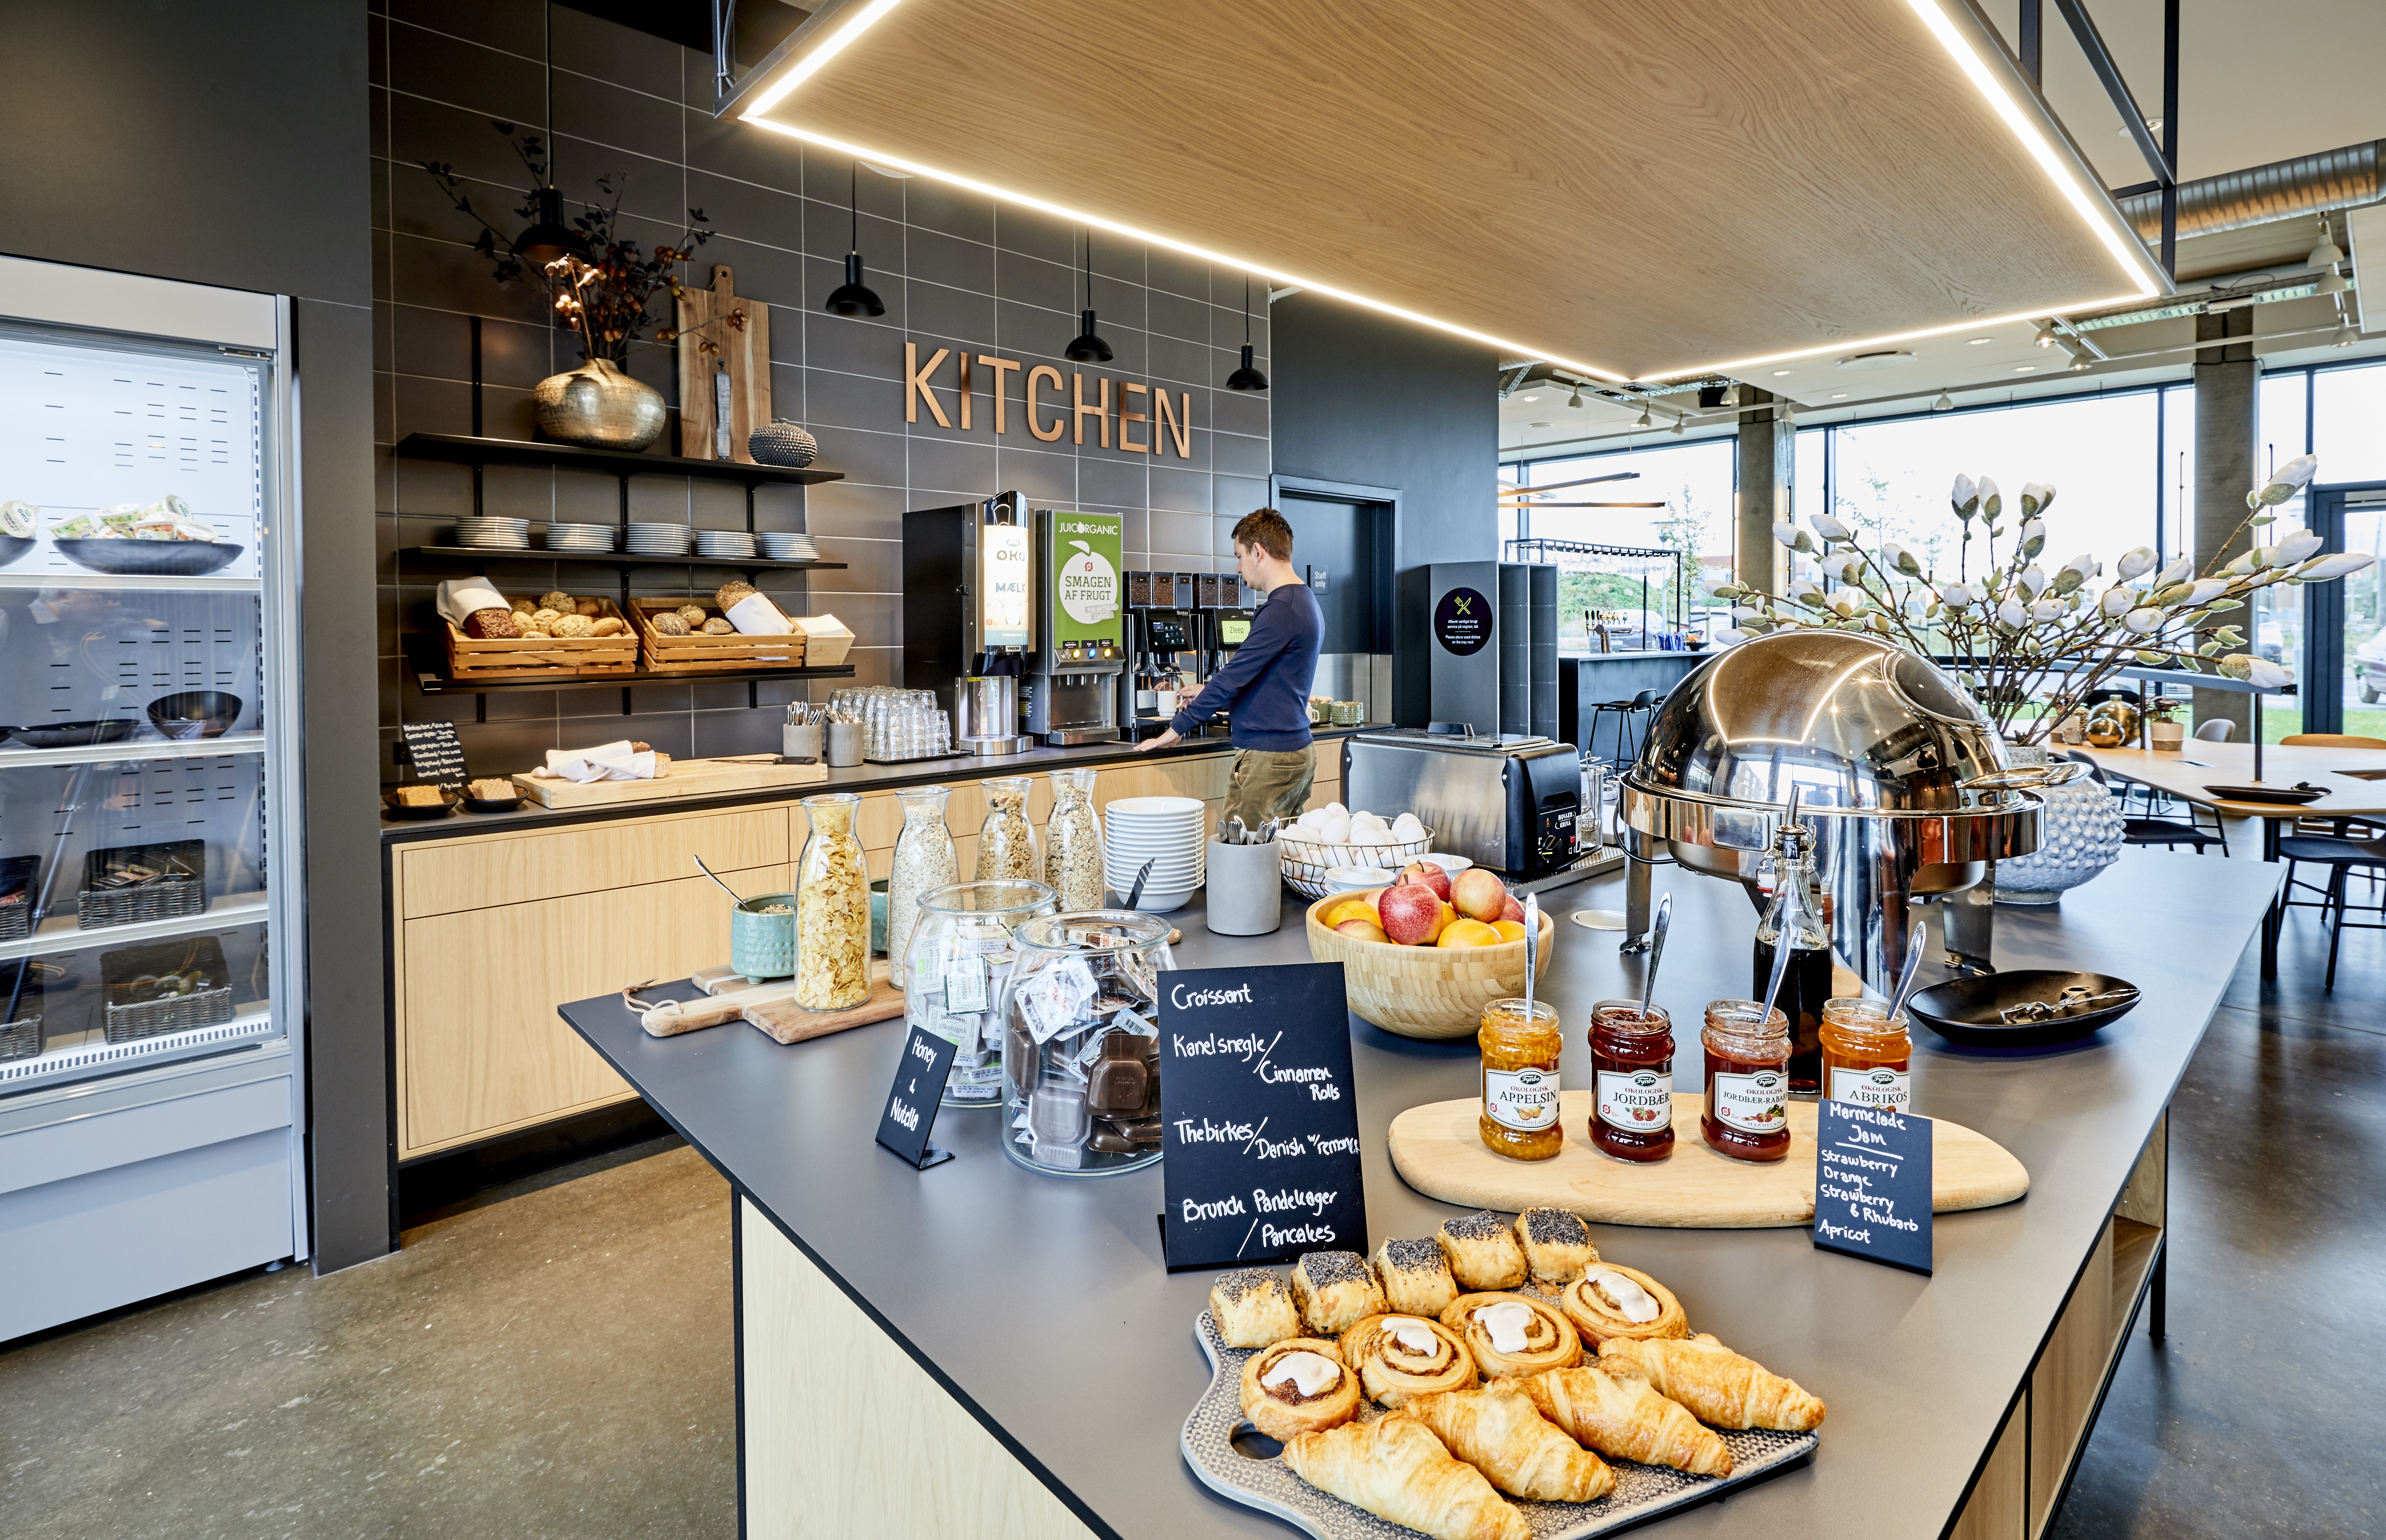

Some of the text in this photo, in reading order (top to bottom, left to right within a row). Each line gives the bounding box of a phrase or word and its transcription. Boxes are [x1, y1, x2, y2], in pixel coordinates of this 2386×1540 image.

[906, 342, 1190, 458] KITCHEN
[996, 550, 1025, 562] ØKO
[996, 582, 1025, 593] MÆLK
[1065, 576, 1111, 587] SMAGEN
[1315, 580, 1326, 589] only
[1065, 590, 1110, 600] AF FRUGT
[1558, 812, 1573, 821] ROLLER
[1171, 983, 1253, 1010] Croissant
[941, 1014, 967, 1024] Jakobsens
[939, 1023, 967, 1034] Økologisk
[912, 1035, 937, 1072] Honey
[1521, 1075, 1541, 1084] Fynbo
[1636, 1077, 1656, 1085] Fynbo
[1758, 1077, 1777, 1086] Fynbo
[1873, 1075, 1894, 1084] Fynbo
[1309, 1084, 1340, 1100] Rolls
[1500, 1089, 1556, 1104] APPELSIN
[1613, 1092, 1669, 1106] JORDBÆR
[1850, 1090, 1907, 1103] ABRIKOS
[890, 1097, 919, 1131] Nutella
[1830, 1102, 1906, 1130] Marmelade
[1848, 1124, 1887, 1146] Jam
[1255, 1137, 1306, 1159] Danish
[1821, 1150, 1897, 1178] Strawberry
[1824, 1166, 1873, 1192] Orange
[1183, 1188, 1337, 1223] Brunch Pandekager
[1820, 1184, 1894, 1214] Strawberry
[1863, 1207, 1918, 1231] Rhubarb
[1819, 1219, 1870, 1244] Apricot
